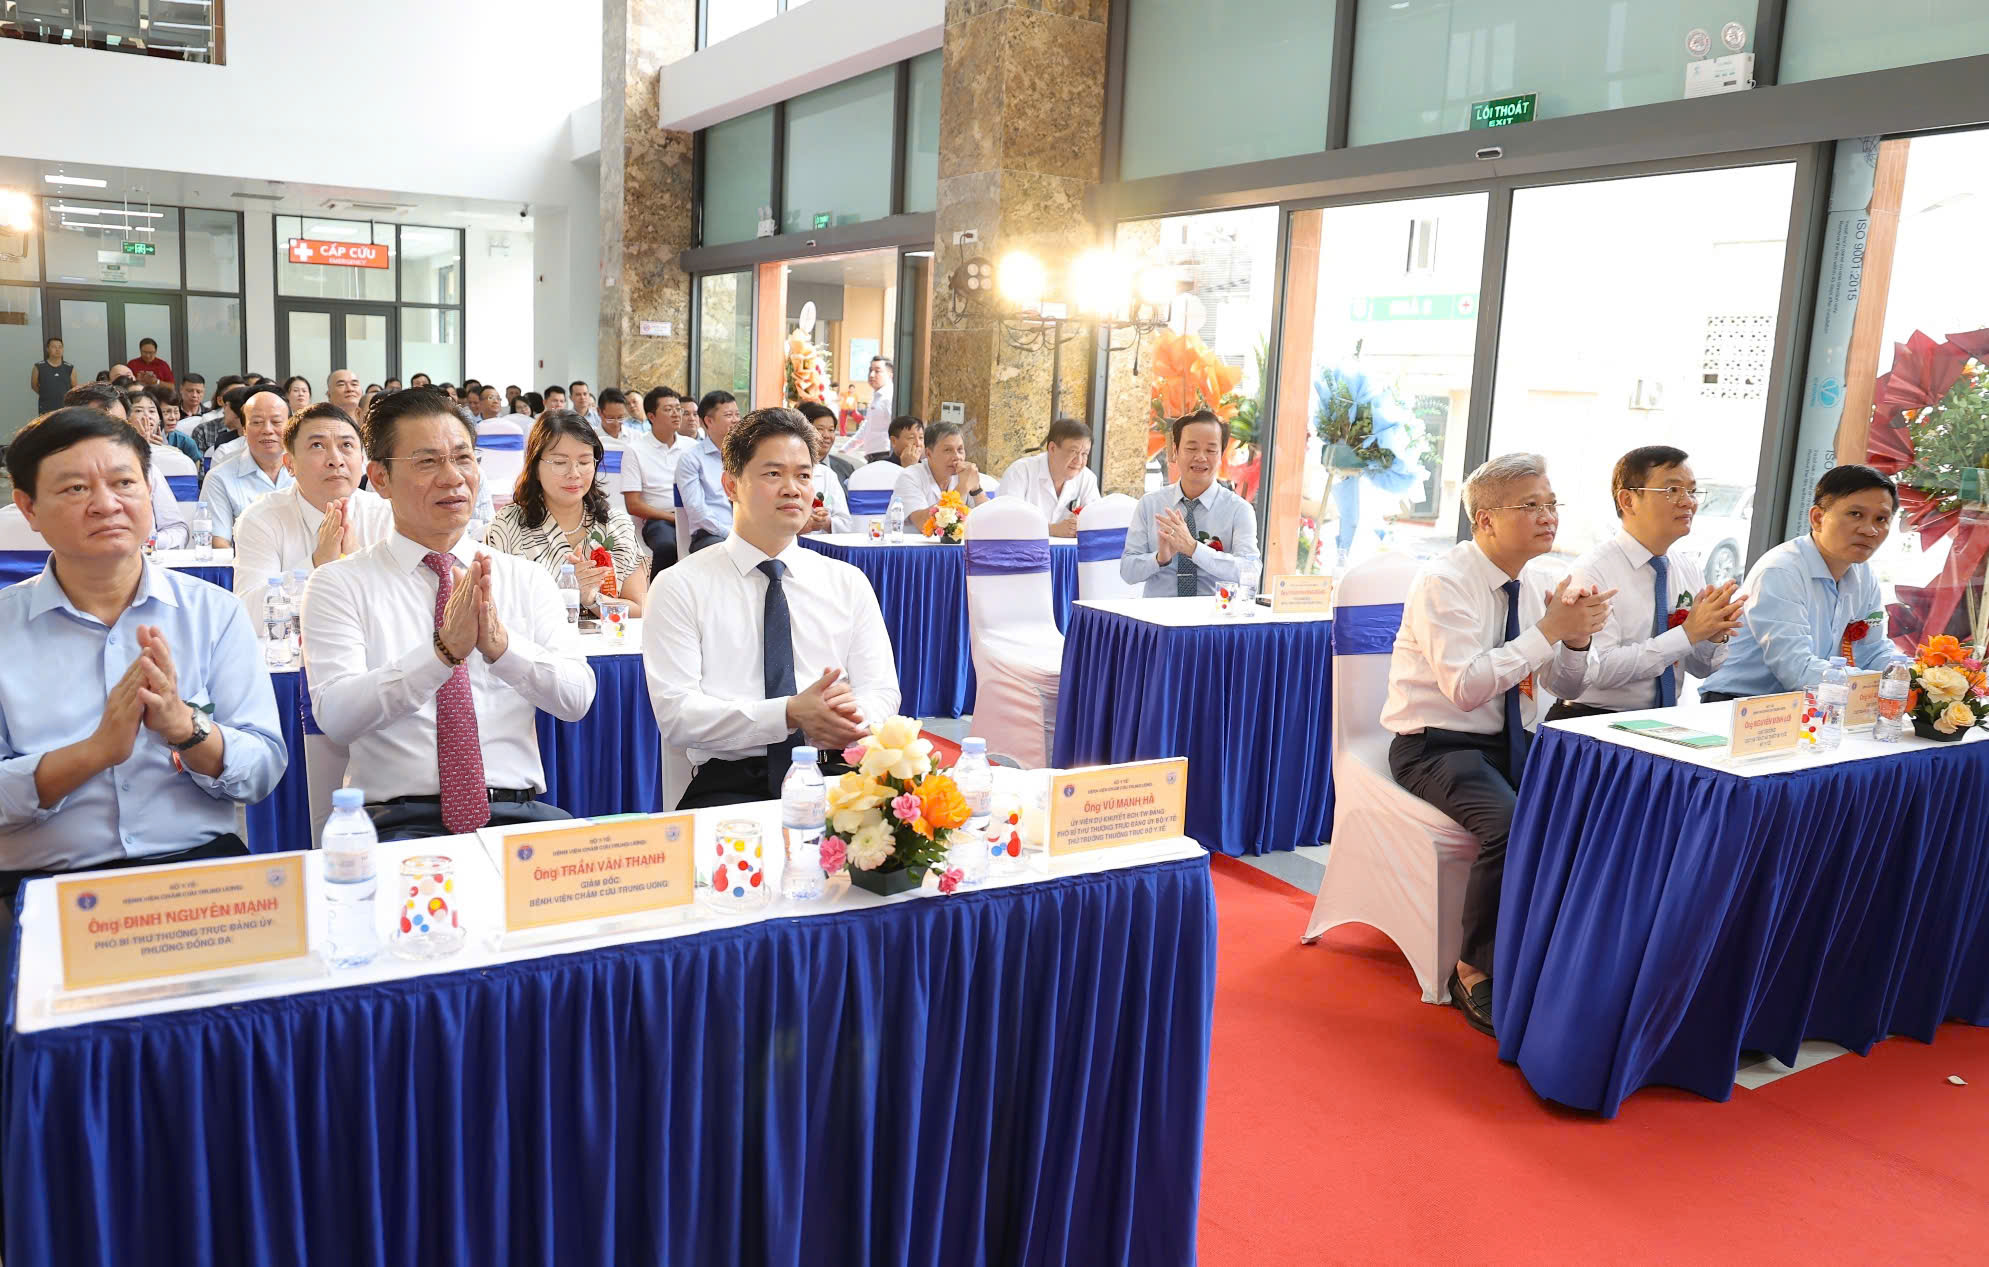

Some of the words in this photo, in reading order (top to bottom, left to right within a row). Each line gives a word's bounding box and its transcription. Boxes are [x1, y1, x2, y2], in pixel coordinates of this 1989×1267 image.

[1495, 99, 1529, 117] THOÁT
[1488, 117, 1513, 128] EXIT
[1855, 219, 1867, 240] ISO
[320, 242, 346, 256] CẤP
[349, 245, 376, 259] CỨU
[1847, 243, 1864, 301] 9001:2015
[1084, 801, 1101, 813] Ông
[1103, 797, 1114, 810] VŨ
[1116, 797, 1140, 810] MẠNH
[1143, 793, 1154, 805] HÀ
[534, 866, 557, 881] Ông
[560, 859, 594, 877] TRẦN
[597, 856, 622, 872] VĂN
[580, 878, 600, 889] GIÁM
[618, 883, 645, 894] TRUNG
[88, 916, 119, 935] Ông
[233, 897, 279, 916] MẠNH
[229, 919, 257, 932] ĐẢNG
[217, 935, 232, 945] ĐA
